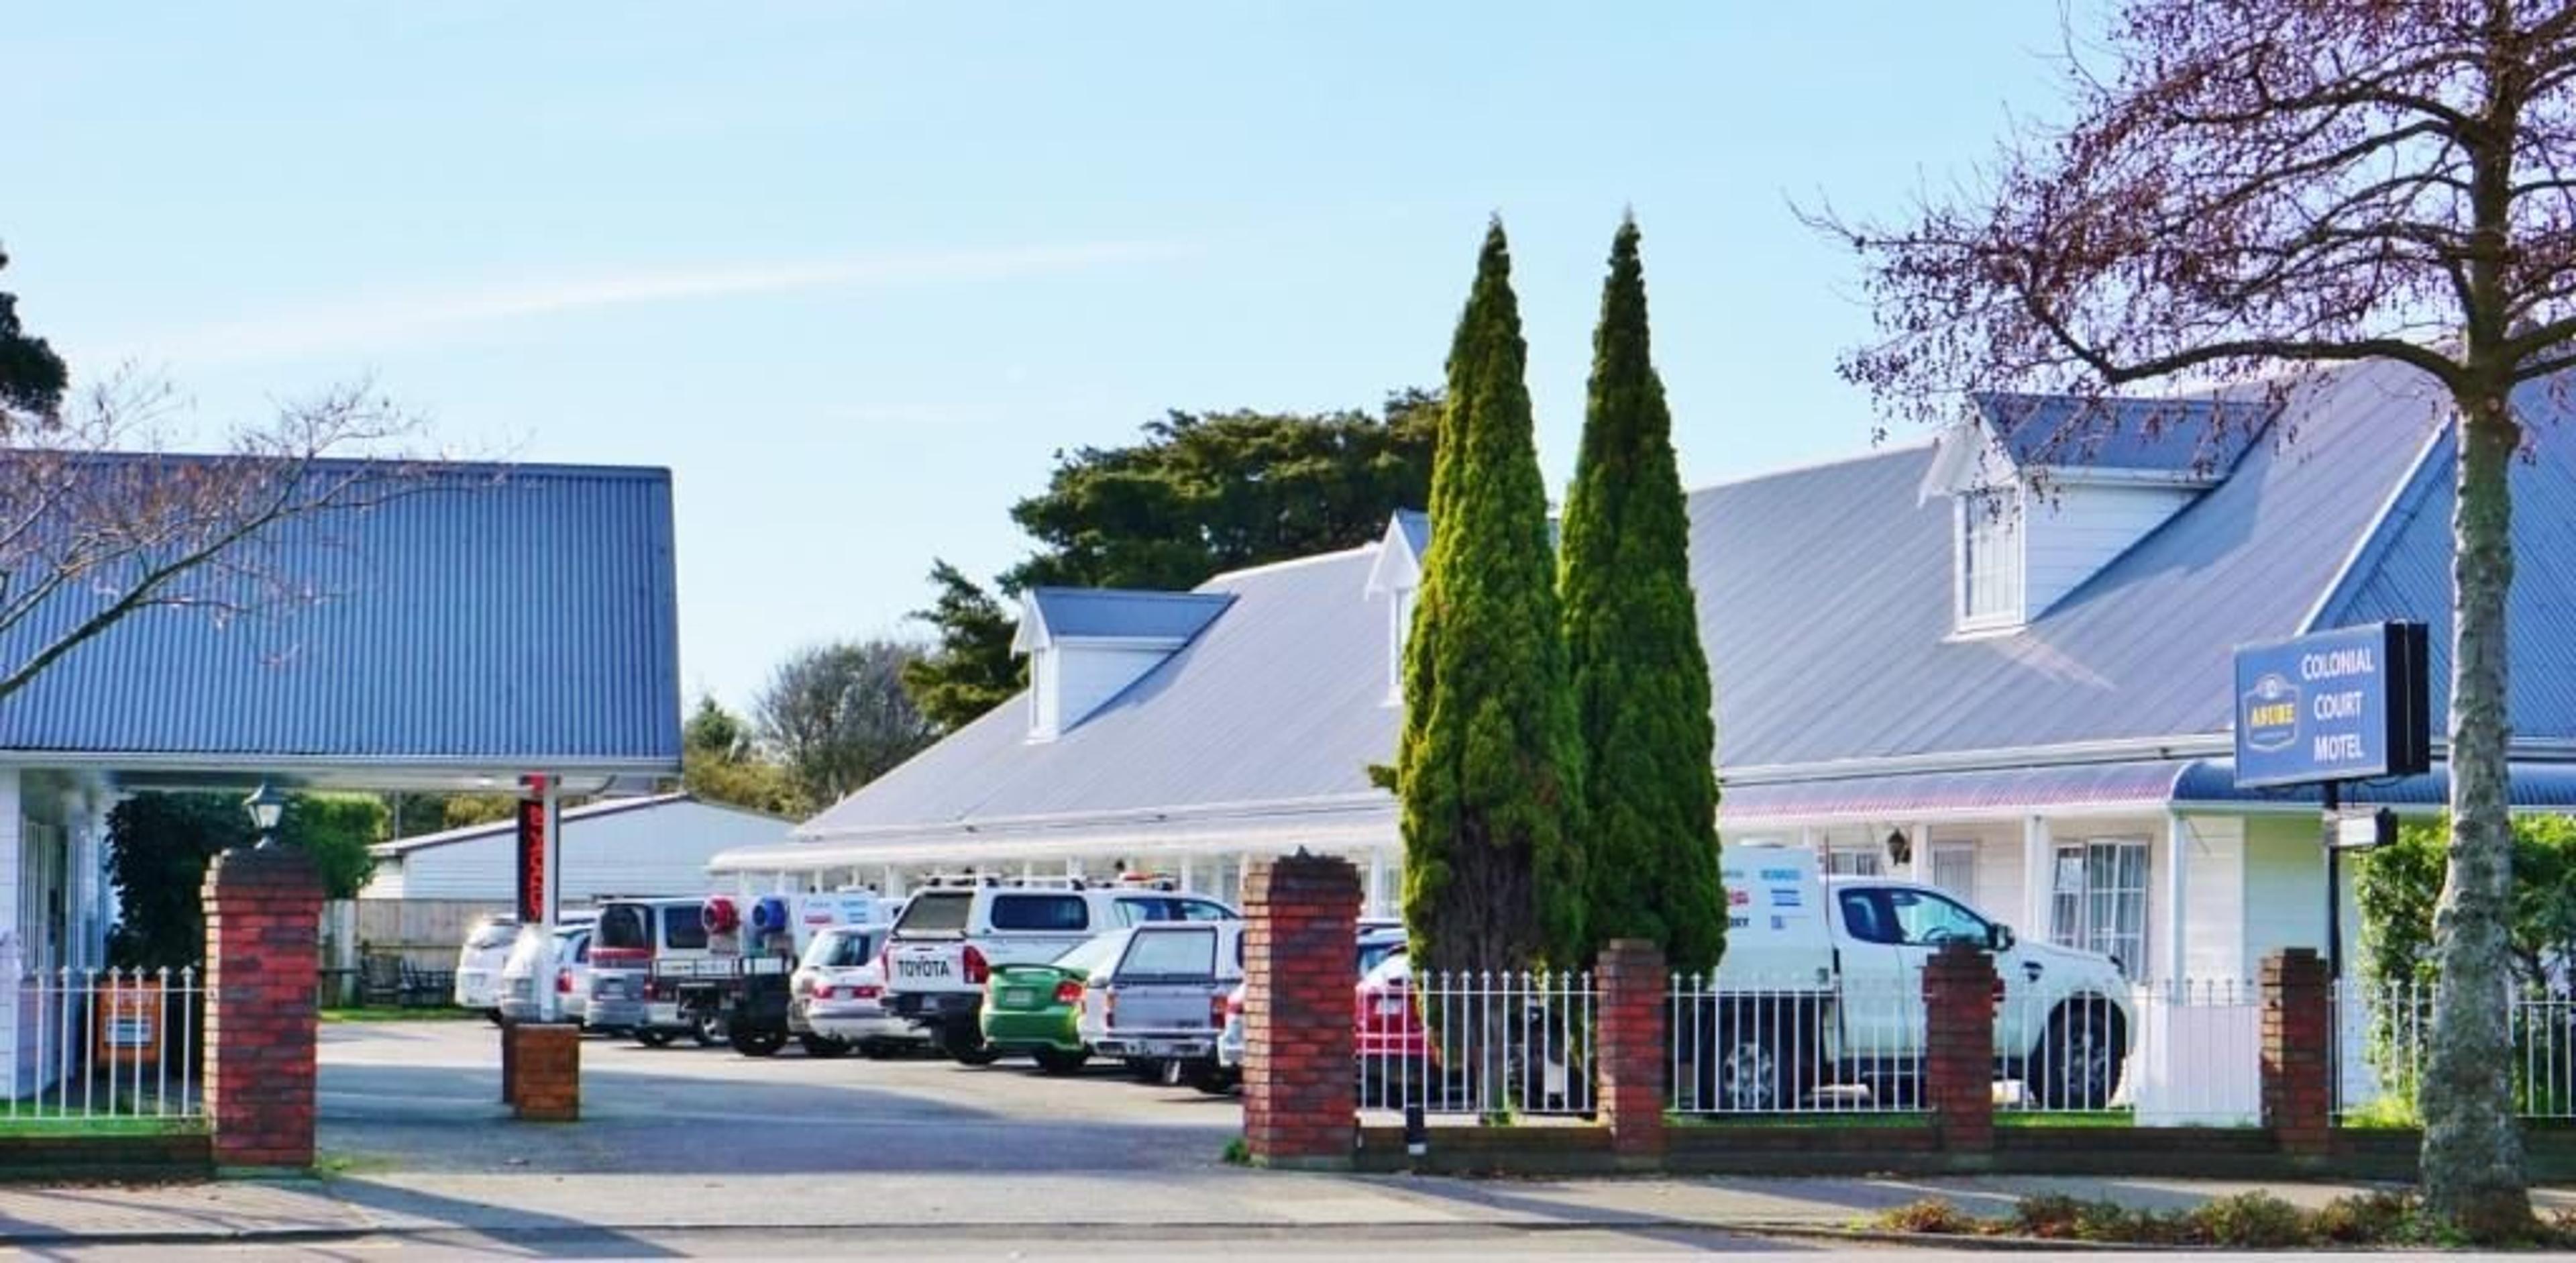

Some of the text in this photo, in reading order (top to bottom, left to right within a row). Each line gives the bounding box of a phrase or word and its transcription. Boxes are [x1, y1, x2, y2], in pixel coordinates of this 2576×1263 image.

[2302, 648, 2375, 680] COLONIAL
[2314, 691, 2363, 720] COURT
[2314, 734, 2364, 762] MOTEL
[898, 960, 949, 976] TOYOTA
